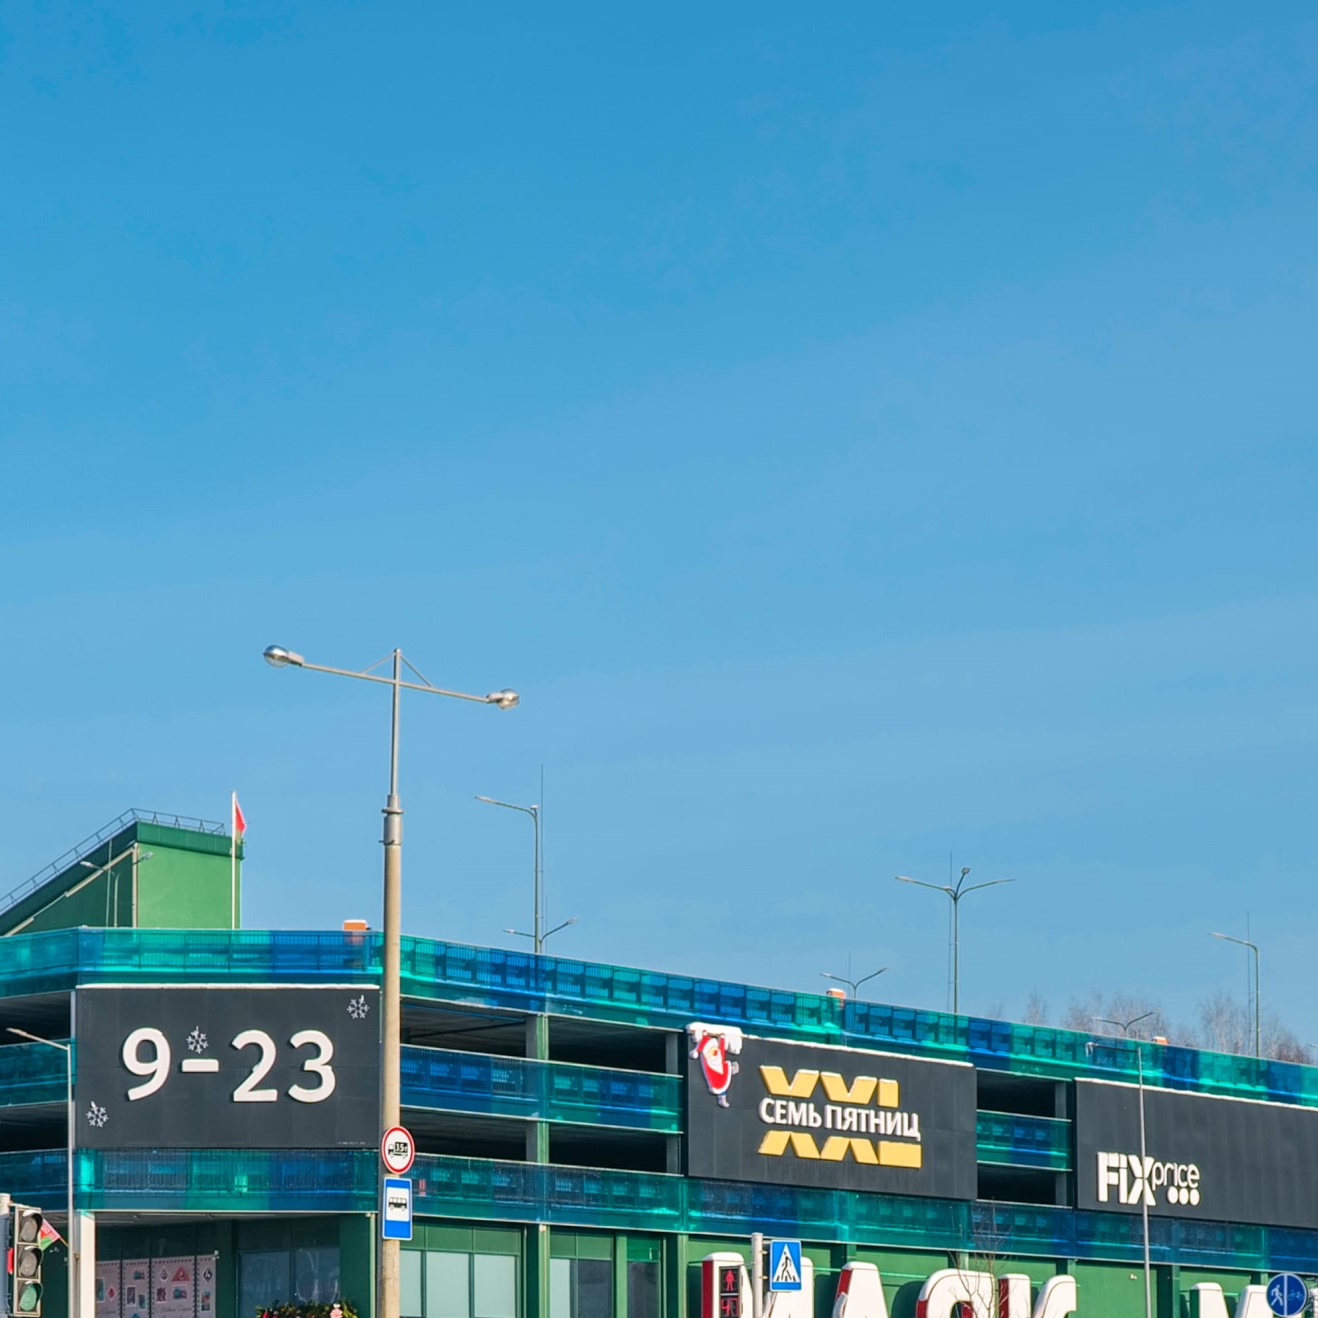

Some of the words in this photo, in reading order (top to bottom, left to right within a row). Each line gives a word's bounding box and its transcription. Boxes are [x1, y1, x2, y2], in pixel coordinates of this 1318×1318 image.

[121, 1026, 336, 1103] 9-23
[758, 1096, 823, 1129] СЕМЬ
[824, 1103, 922, 1142] ПЯТНИЦ
